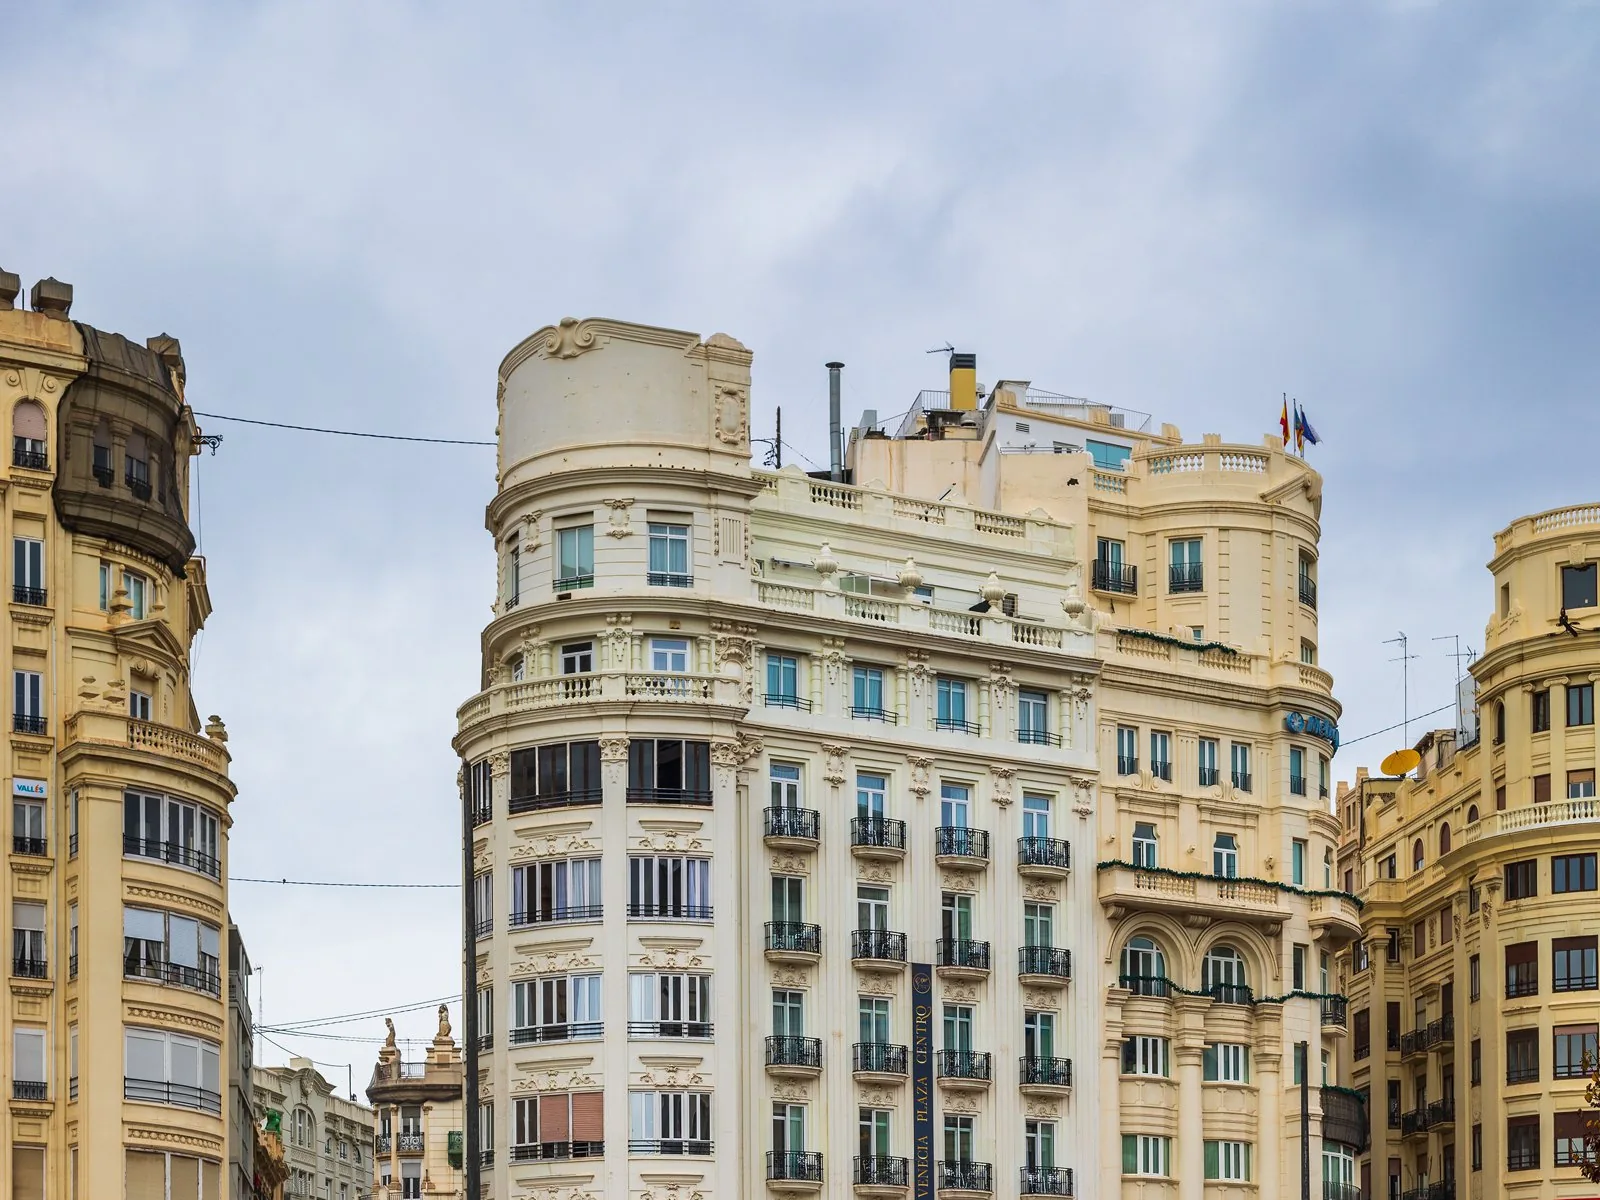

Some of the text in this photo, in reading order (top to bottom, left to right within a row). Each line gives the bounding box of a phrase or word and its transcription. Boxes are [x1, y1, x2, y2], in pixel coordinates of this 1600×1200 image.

[16, 784, 44, 793] VALLÉS
[916, 1005, 932, 1198] VENECIA PLAZA CENTRO
